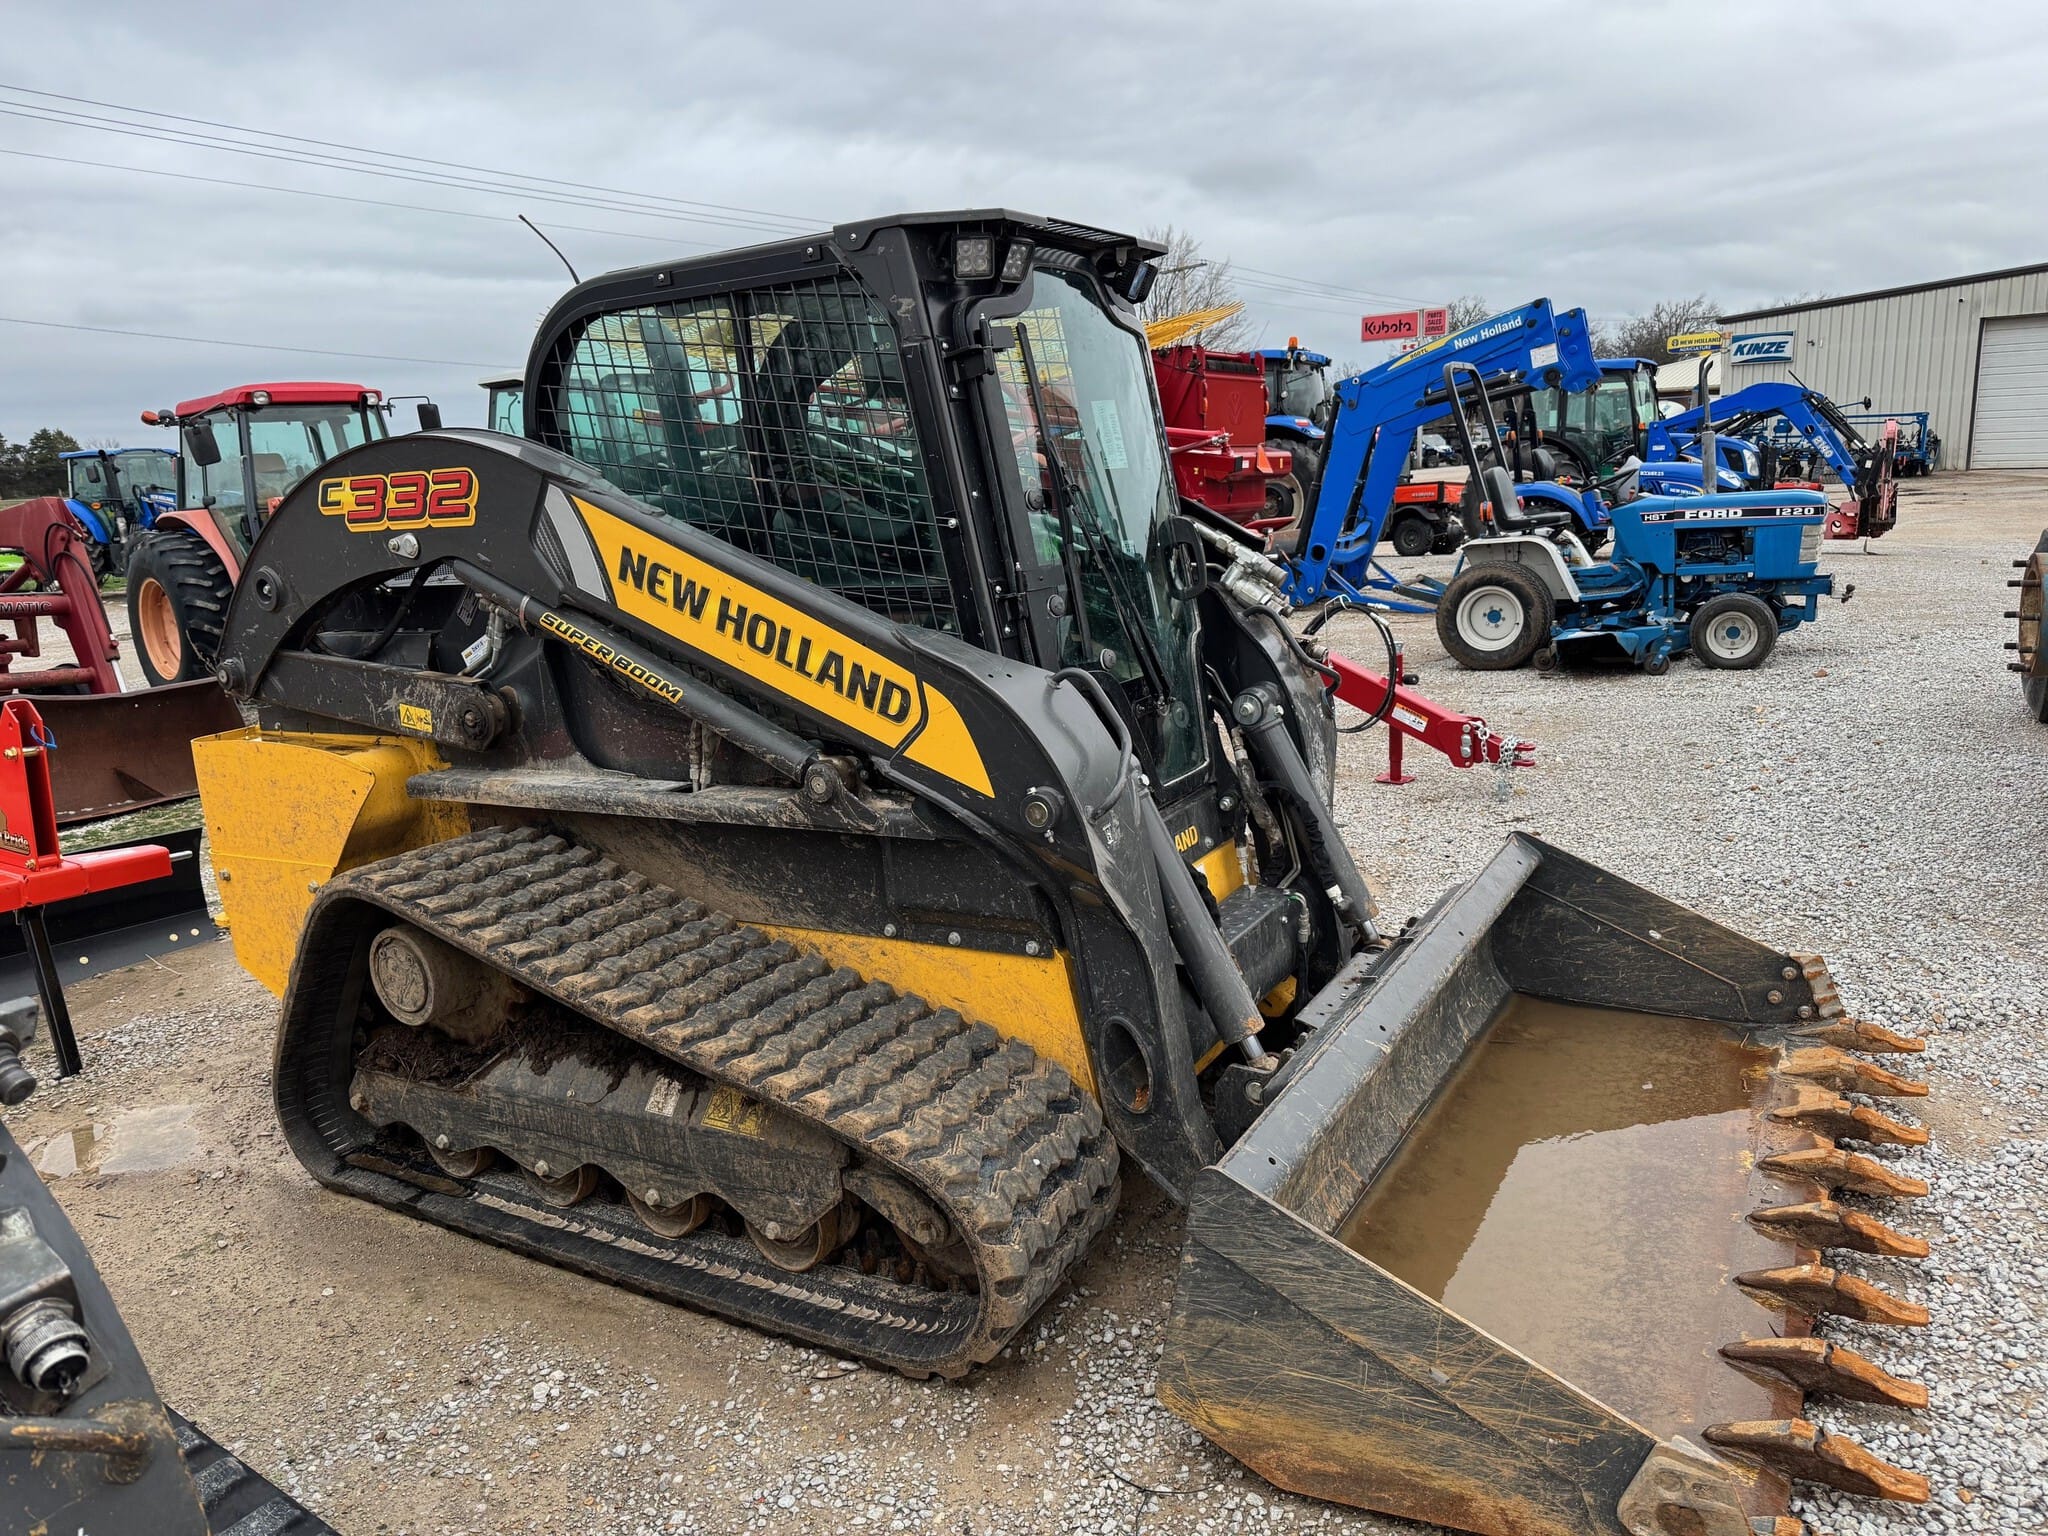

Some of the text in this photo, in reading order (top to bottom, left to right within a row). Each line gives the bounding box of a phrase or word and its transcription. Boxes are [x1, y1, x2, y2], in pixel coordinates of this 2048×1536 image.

[1365, 319, 1412, 335] Kubota
[1425, 325, 1443, 333] SERVICE
[1454, 316, 1522, 350] New Holland
[1694, 336, 1721, 344] HOLLAND
[1733, 341, 1789, 356] KINZE
[320, 467, 478, 527] C332
[1644, 507, 1815, 521] HST FORD 1220
[618, 545, 912, 725] NEW HOLLAND
[540, 612, 683, 703] SUPER BOOM
[1174, 825, 1198, 852] AND
